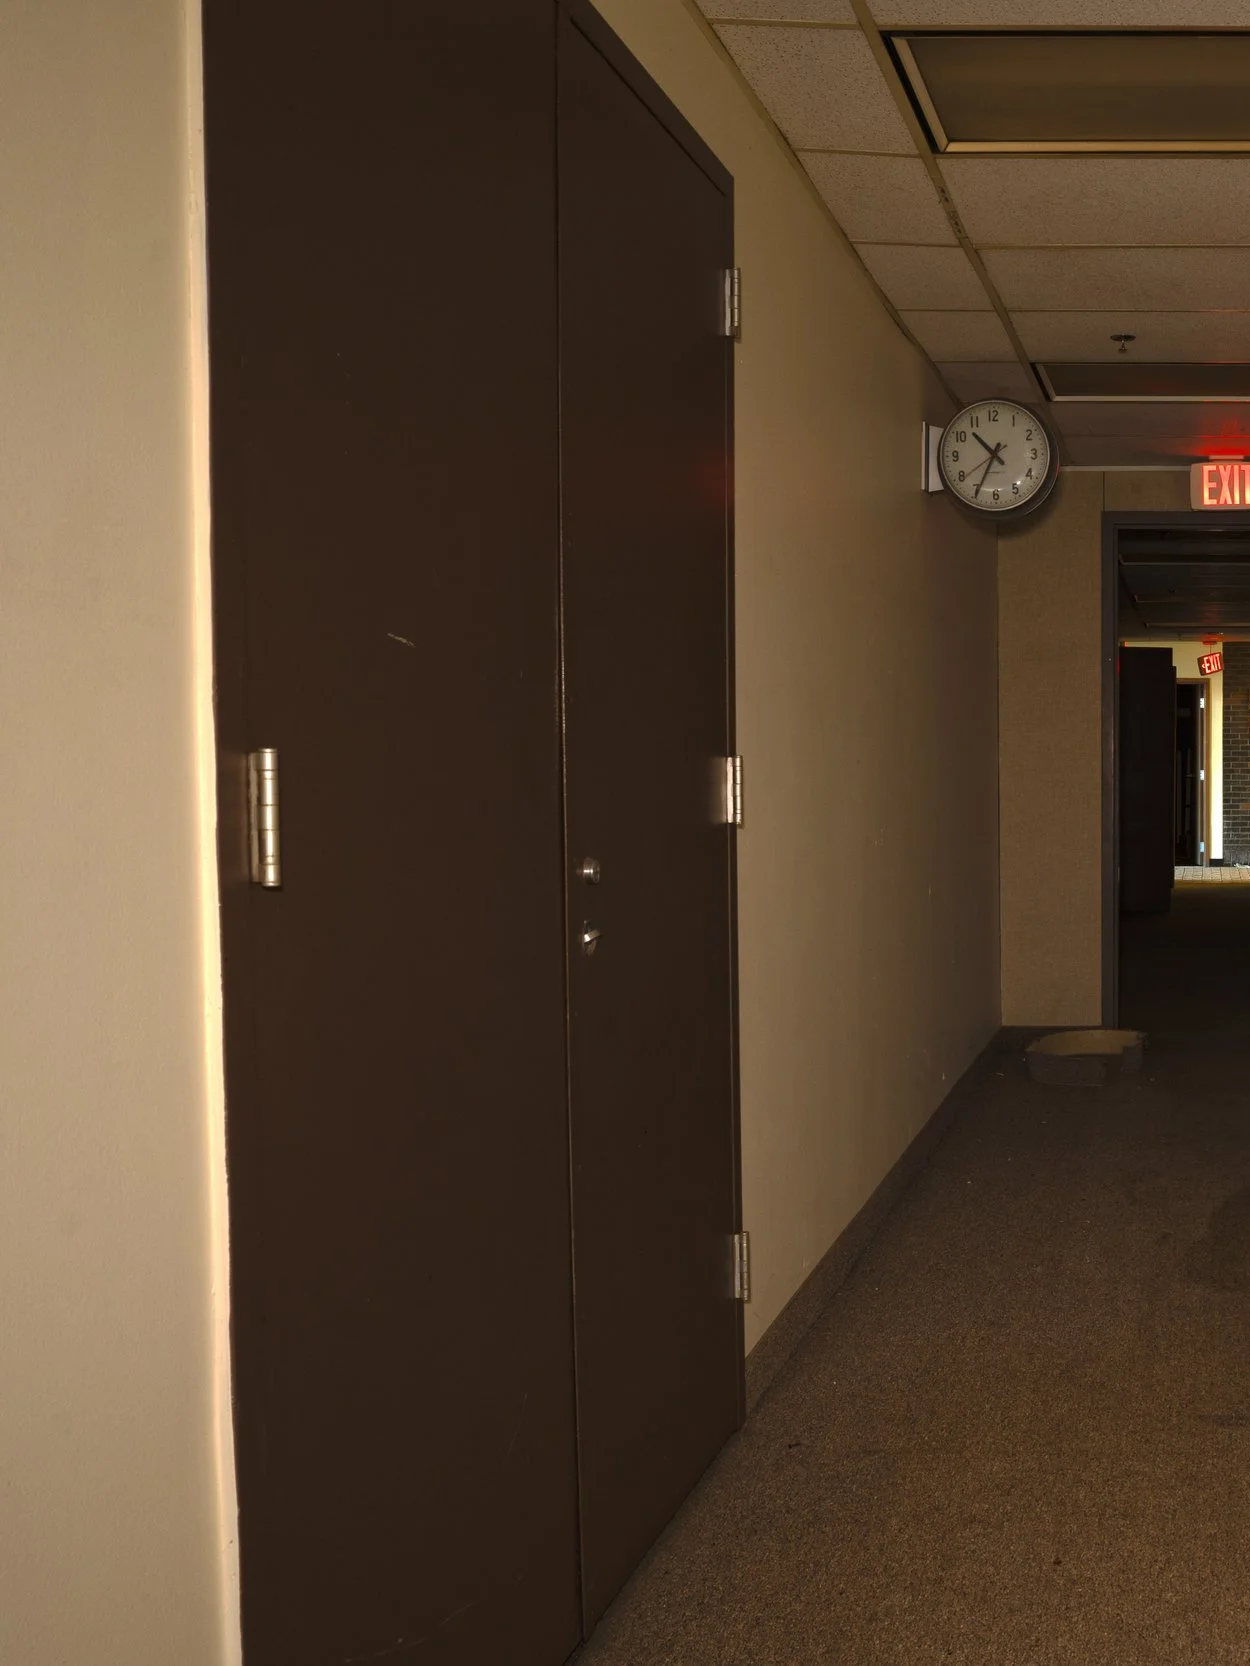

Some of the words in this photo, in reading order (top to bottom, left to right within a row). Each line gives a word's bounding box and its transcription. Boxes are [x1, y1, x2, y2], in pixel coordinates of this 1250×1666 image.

[970, 416, 979, 428] 11
[988, 410, 999, 422] 12
[955, 431, 967, 443] 10
[1025, 429, 1033, 441] 2
[951, 450, 959, 462] 9
[1030, 448, 1038, 460] 3
[958, 471, 966, 483] 8
[1025, 468, 1033, 480] 4
[992, 489, 1000, 501] 6
[1012, 483, 1019, 495] 5
[1204, 653, 1222, 674] EXIT
